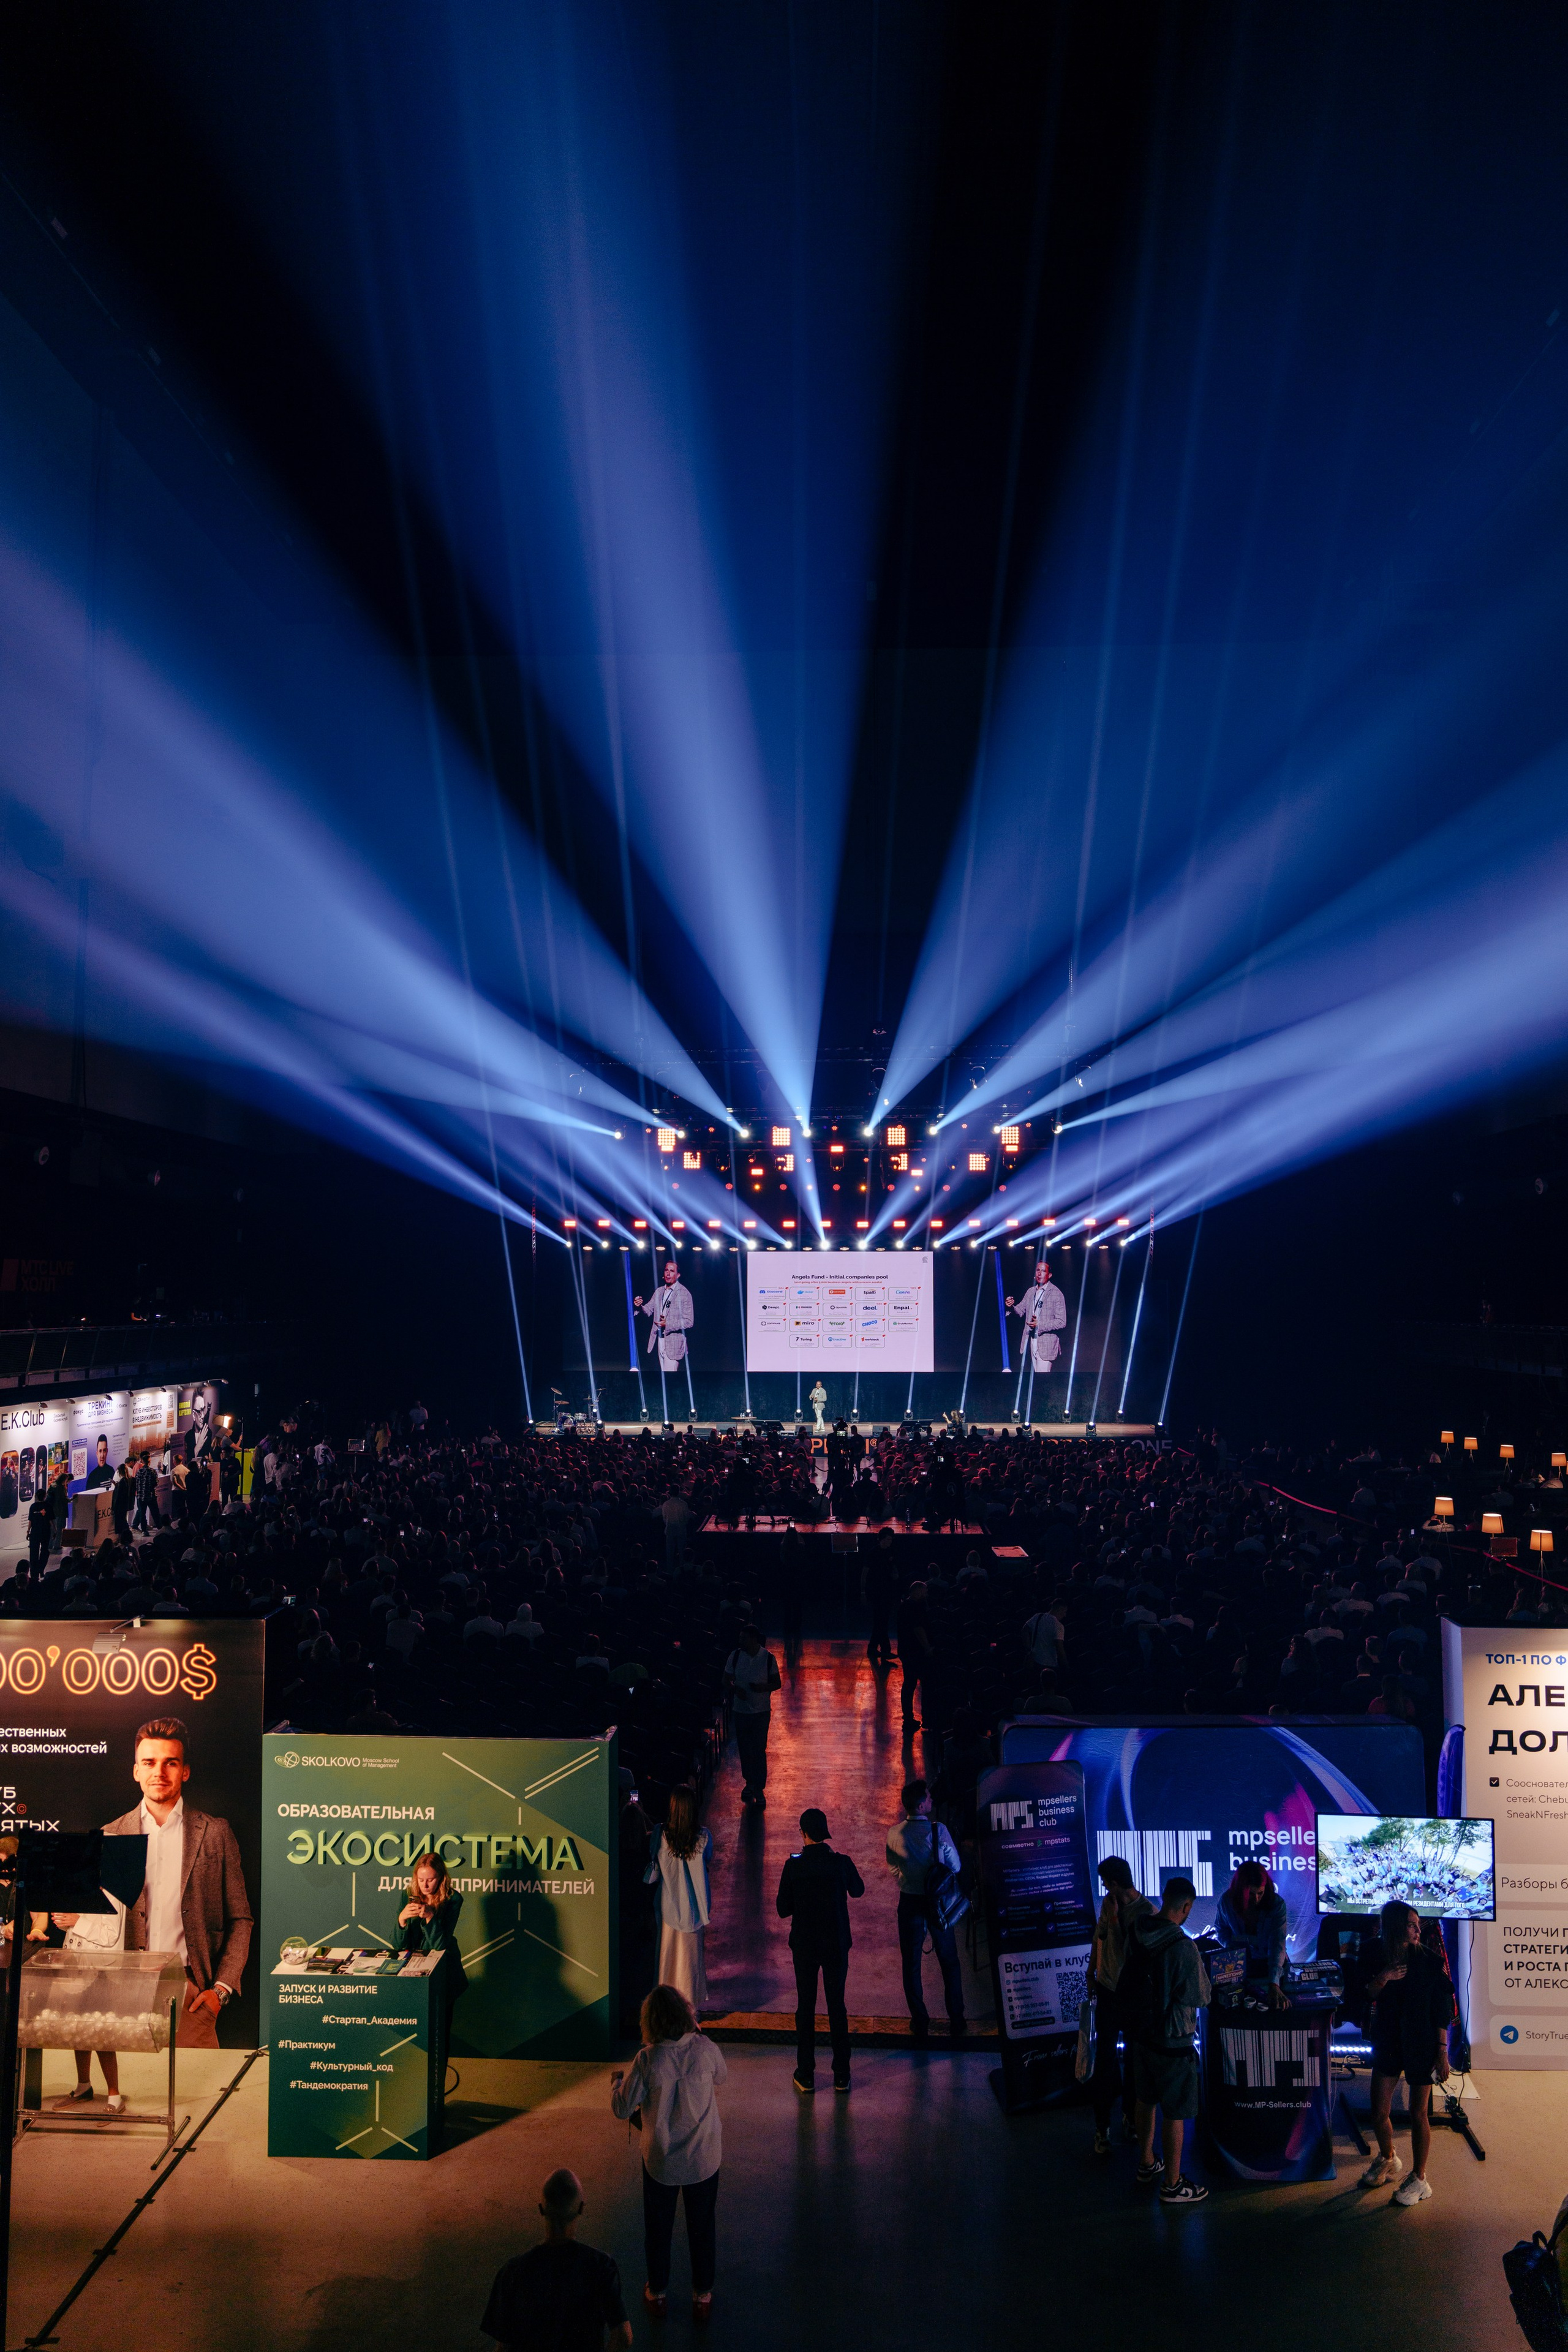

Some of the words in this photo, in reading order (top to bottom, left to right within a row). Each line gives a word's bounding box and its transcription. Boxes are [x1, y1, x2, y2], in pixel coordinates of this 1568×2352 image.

[1, 1409, 45, 1431] E.K.Club
[1485, 1654, 1526, 1664] ТОП-1
[1531, 1654, 1551, 1665] ПО
[1487, 1684, 1566, 1707] АЛЕ
[11, 1741, 107, 1754] возможностей
[1488, 1729, 1568, 1755] ДОЛ
[301, 1756, 361, 1768] SKOLKOVO
[0, 1787, 17, 1799] Б
[1506, 1795, 1536, 1803] сетей:
[1038, 1795, 1077, 1807] mpsellers
[277, 1803, 435, 1820] ОБРАЗОВАТЕЛЬНАЯ
[1038, 1806, 1075, 1817] business
[1039, 1817, 1058, 1828] club
[1044, 1837, 1071, 1847] mpstats
[286, 1829, 585, 1872] ЭКОСИСТЕМА
[378, 1876, 412, 1893] ДЛЯ
[450, 1877, 595, 1895] ДПРИНИМАТЕЛЕЙ
[1501, 1876, 1557, 1890] Разборы
[1504, 1926, 1558, 1937] ПОЛУЧИ
[1504, 1944, 1568, 1954] СТРАТЕГИ
[1005, 1957, 1052, 1974] Вступай
[1055, 1959, 1061, 1968] в
[1065, 1953, 1091, 1967] клуб
[1505, 1961, 1513, 1970] И
[1517, 1962, 1561, 1972] РОСТА
[1300, 1972, 1319, 1980] CLUB
[279, 1984, 317, 1994] ЗАПУСК
[318, 1985, 326, 1994] И
[328, 1985, 378, 1994] РАЗВИТИЕ
[1505, 1978, 1521, 1988] ОТ
[1525, 1978, 1568, 1989] АЛЕКС
[279, 1995, 323, 2004] БИЗНЕСА
[322, 2015, 417, 2026] #Стартап_Академия
[278, 2040, 336, 2052] #Практикум
[310, 2060, 393, 2073] #Культурный_код
[290, 2080, 369, 2092] #Тандемократия
